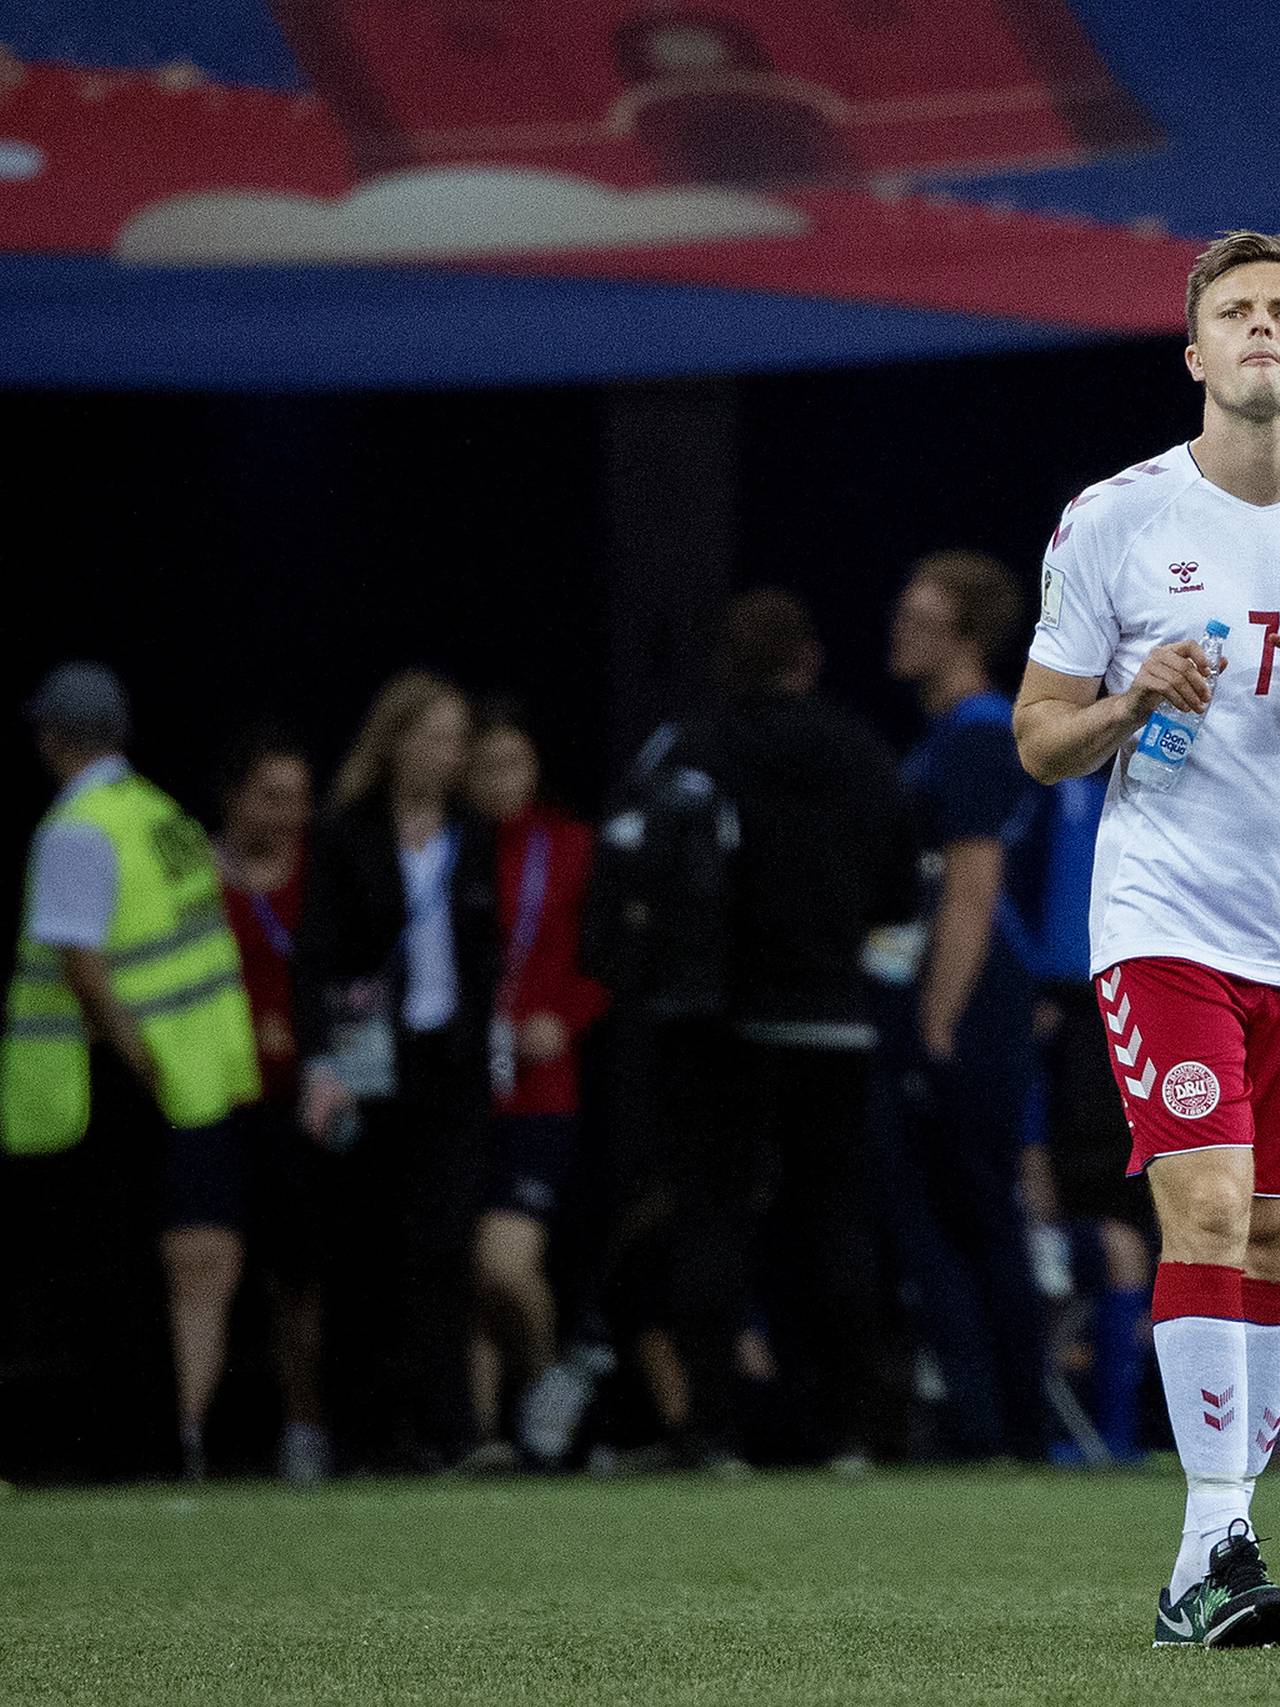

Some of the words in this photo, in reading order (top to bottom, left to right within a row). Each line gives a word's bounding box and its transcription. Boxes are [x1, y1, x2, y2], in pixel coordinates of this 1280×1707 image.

[1169, 582, 1204, 594] hummel
[1248, 610, 1280, 695] 7
[1160, 739, 1186, 755] aqua
[1174, 1080, 1207, 1101] DBU
